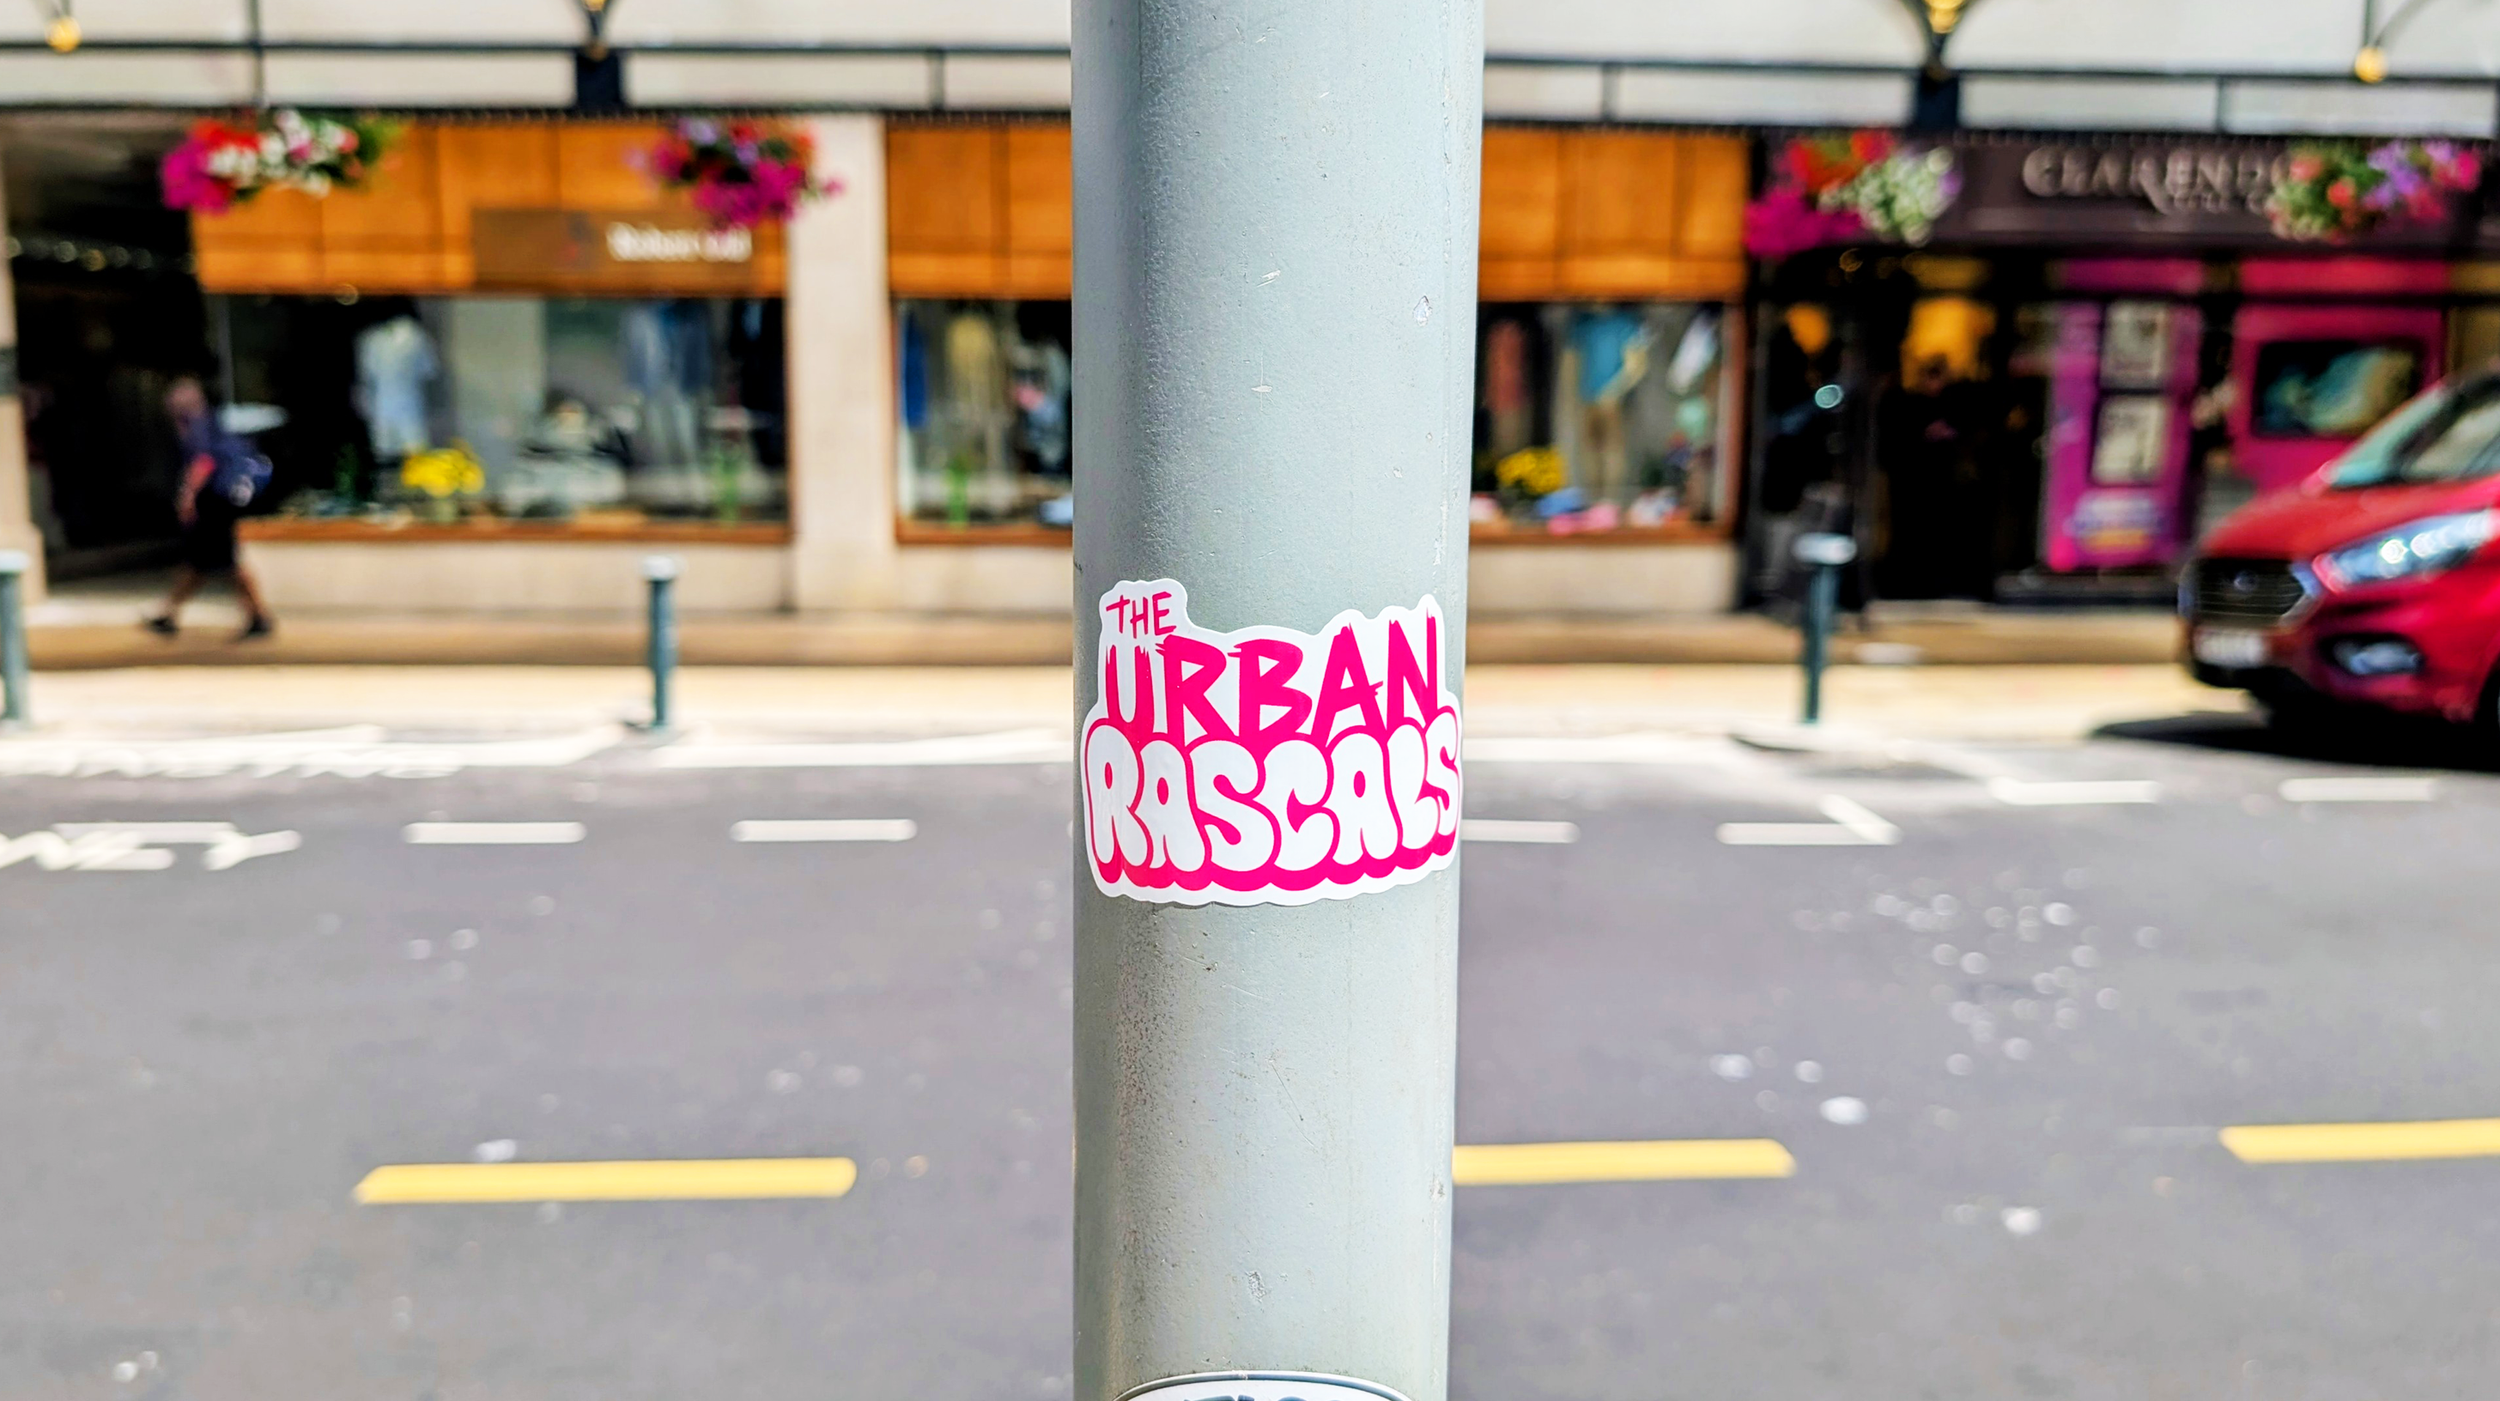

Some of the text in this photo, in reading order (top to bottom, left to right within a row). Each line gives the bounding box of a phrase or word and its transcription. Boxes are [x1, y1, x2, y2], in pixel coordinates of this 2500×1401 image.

[1105, 608, 1438, 746] URBAN
[1106, 591, 1176, 638] THE
[1084, 705, 1462, 892] RASCALS
